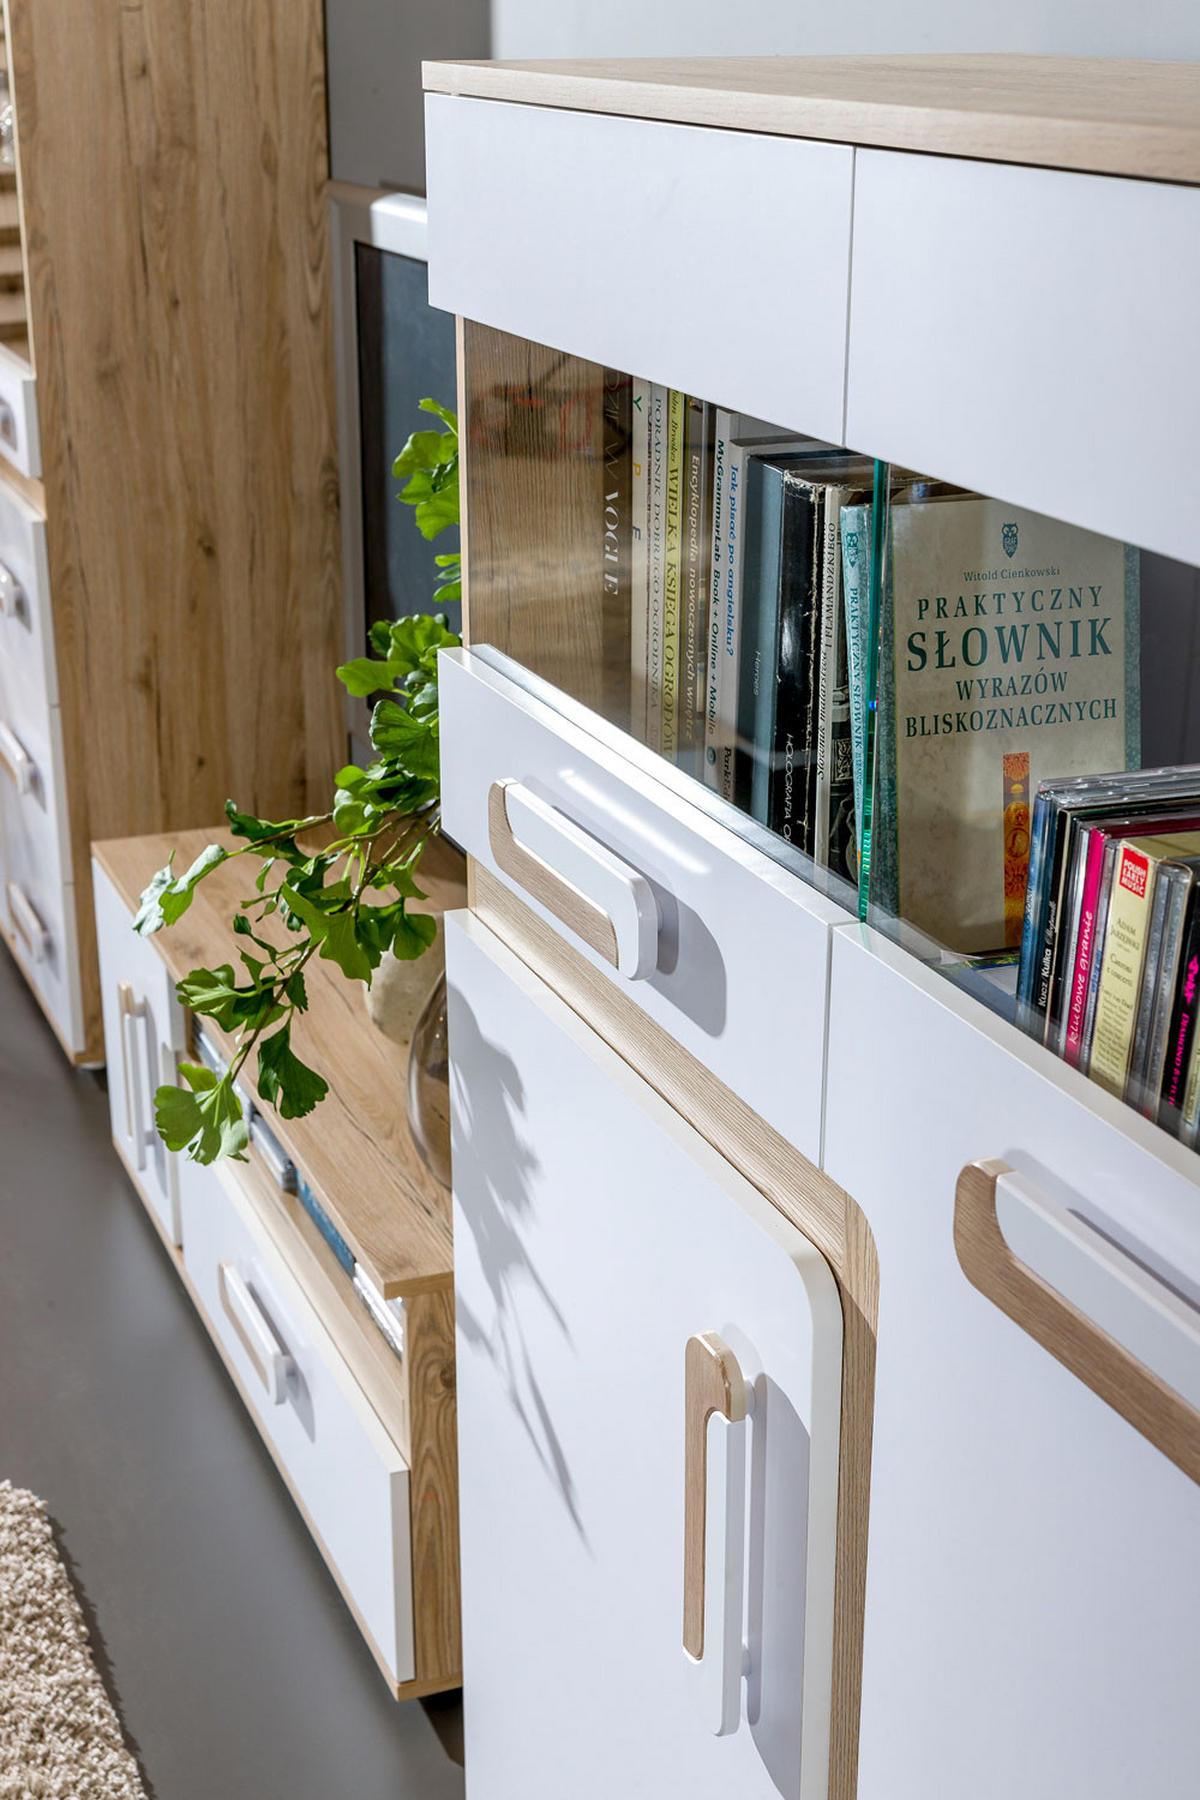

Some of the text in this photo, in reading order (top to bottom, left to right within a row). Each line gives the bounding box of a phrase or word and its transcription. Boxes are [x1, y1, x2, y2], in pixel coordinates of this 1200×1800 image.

[652, 398, 662, 496] PORADNIK
[666, 465, 680, 553] WIELKA
[687, 455, 701, 562] Encyklopedia
[714, 439, 726, 562] MyGrammarLab
[603, 491, 620, 596] VOGUE
[651, 503, 661, 594] DOBREGO
[725, 464, 739, 657] Jak pisać po angielsku?
[822, 522, 837, 640] FLAMANDZKIEGO
[963, 566, 1061, 582] Witold Cienkowski
[685, 568, 697, 680] nowoczesnych
[712, 569, 722, 606] Book
[917, 585, 1103, 620] PRAKTYCZNY
[710, 623, 720, 670] Online
[850, 587, 861, 675] PRAKTYCZNY
[907, 617, 1113, 672] SŁOWNIK
[708, 686, 718, 735] Mobile
[852, 679, 863, 751] SŁOWNIK
[905, 698, 1117, 738] BLISKOZNACZNYCH
[956, 667, 1068, 701] WYRAZÓW
[783, 734, 794, 819] HOLOGRAFIA
[1121, 876, 1145, 896] MUSIC
[1122, 868, 1146, 886] EARLY
[1123, 859, 1147, 877] POLISH
[1068, 973, 1087, 1044] klubowe
[1079, 910, 1093, 972] granie
